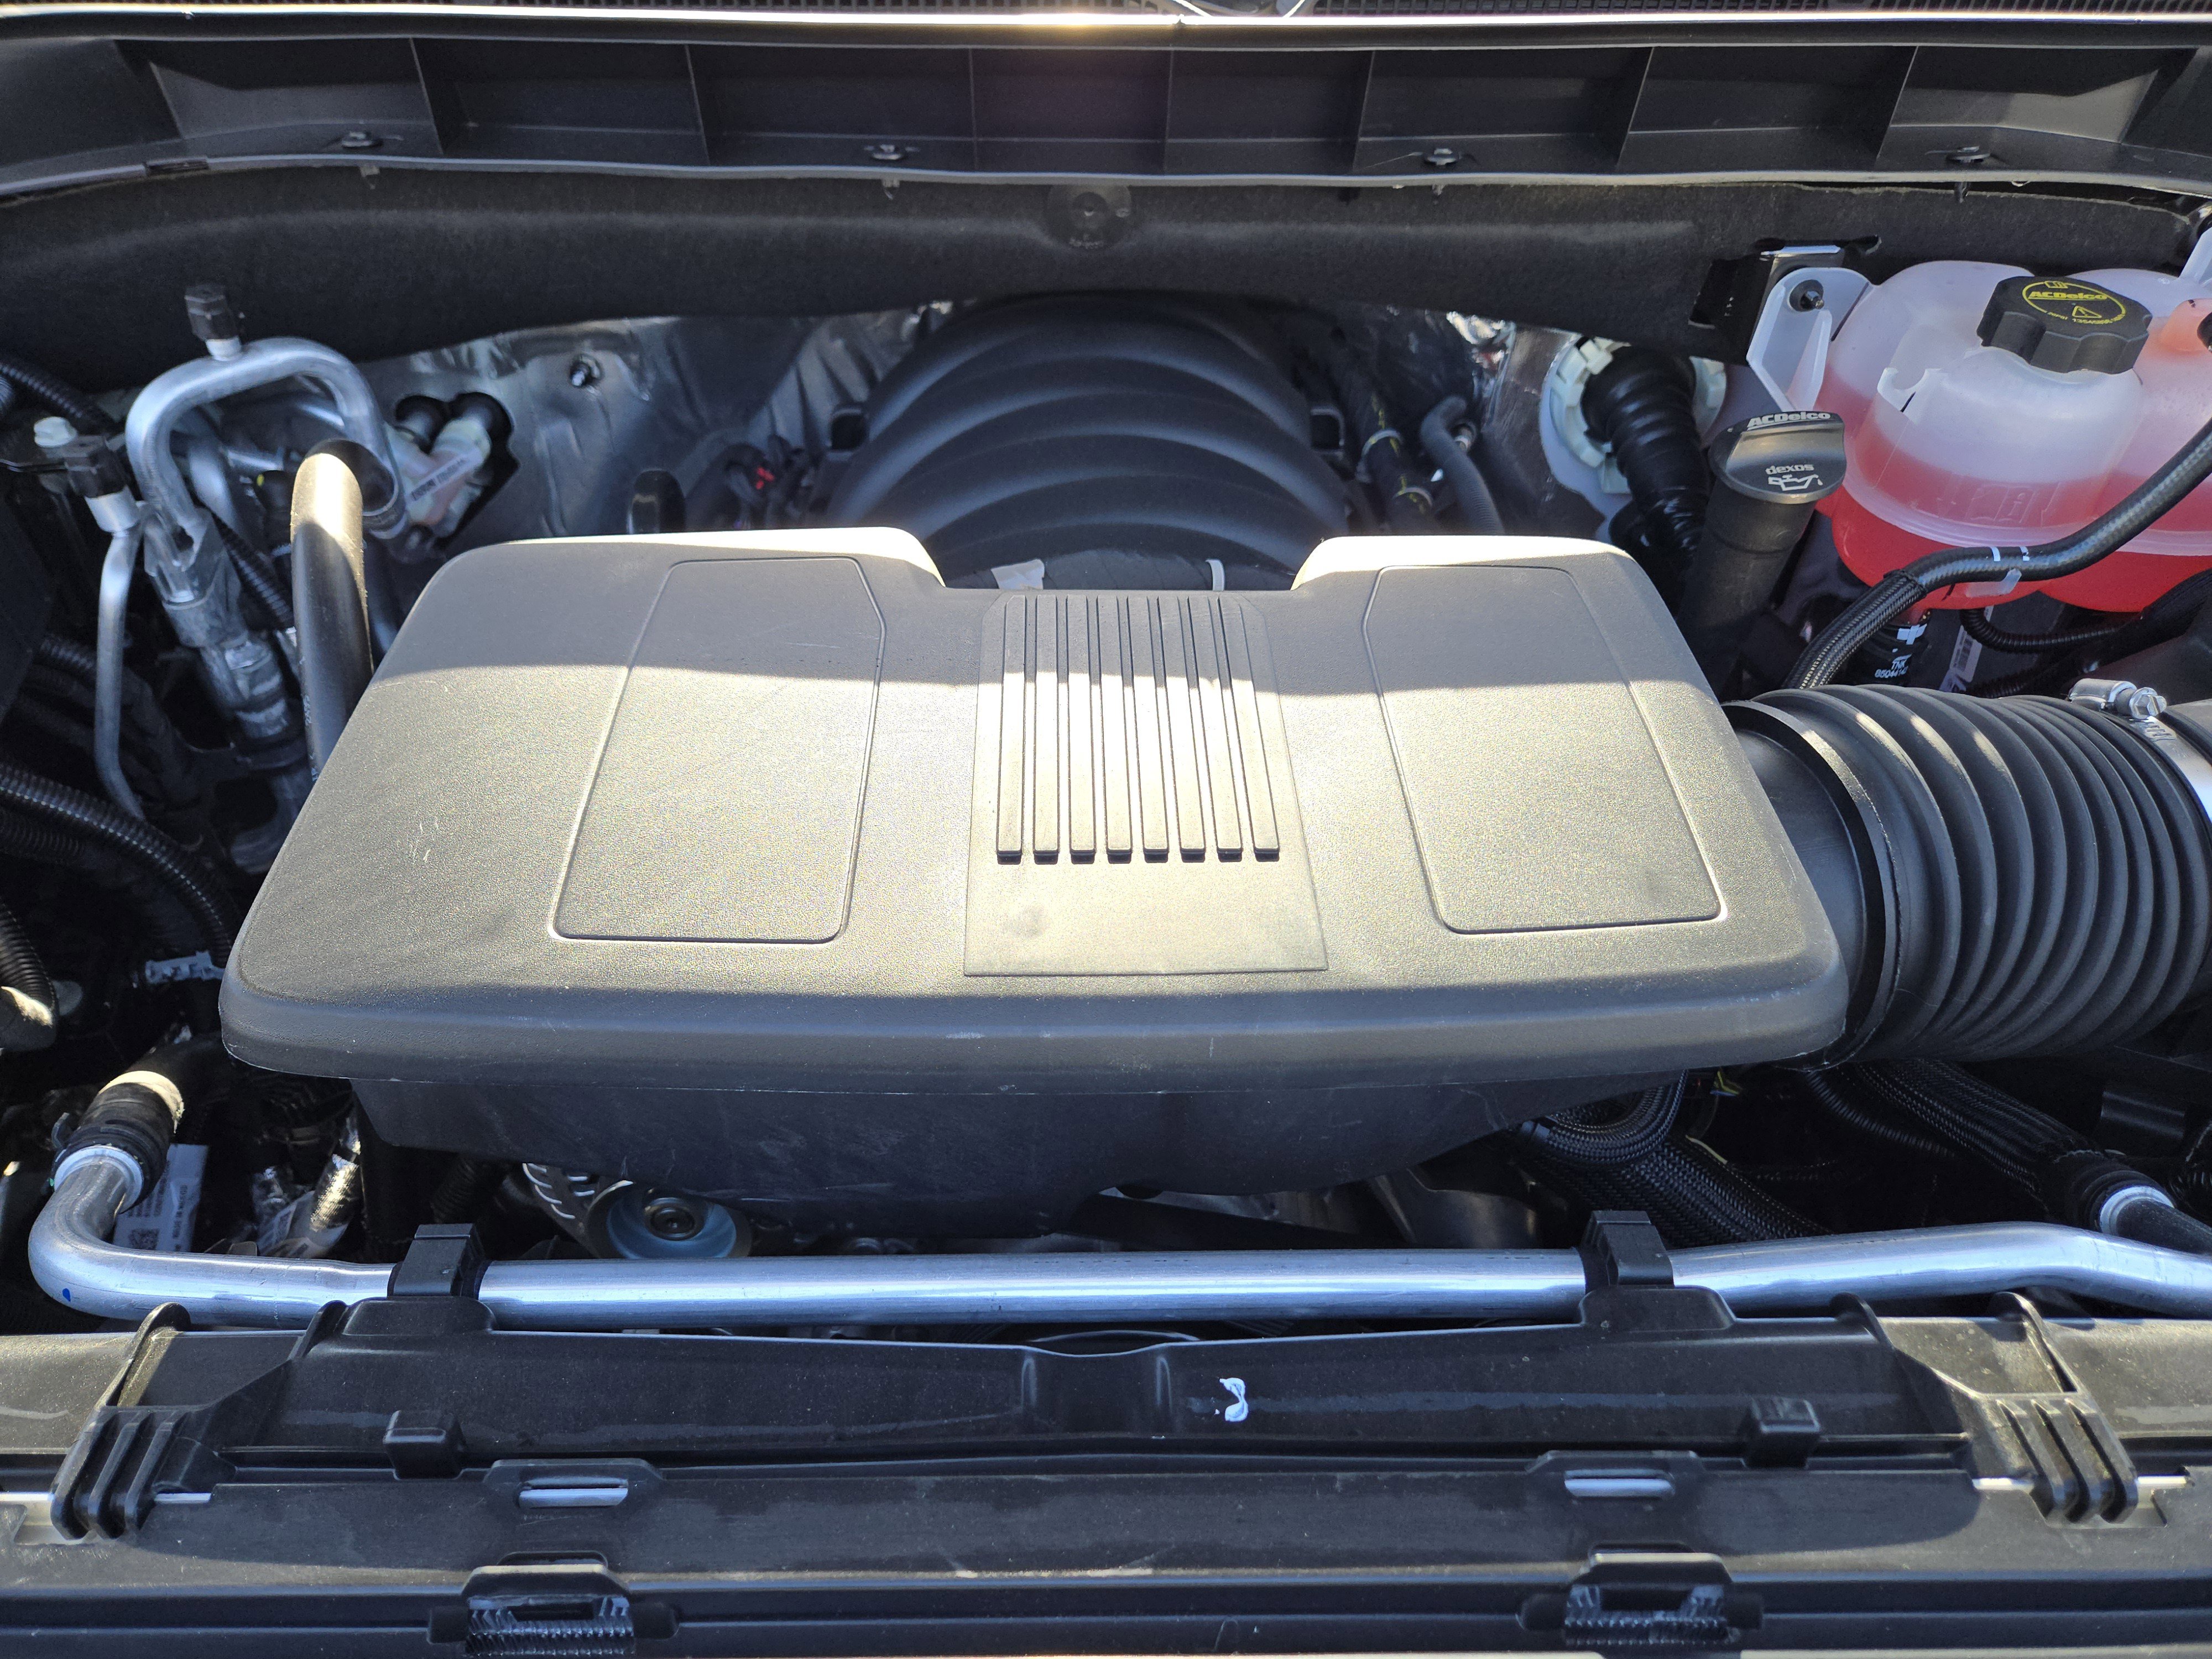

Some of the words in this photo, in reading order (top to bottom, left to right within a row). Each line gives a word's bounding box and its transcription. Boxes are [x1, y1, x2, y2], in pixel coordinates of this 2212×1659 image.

[2028, 291, 2109, 300] ACDelco
[1747, 411, 1831, 429] ACDelco
[1765, 464, 1814, 474] dexos
